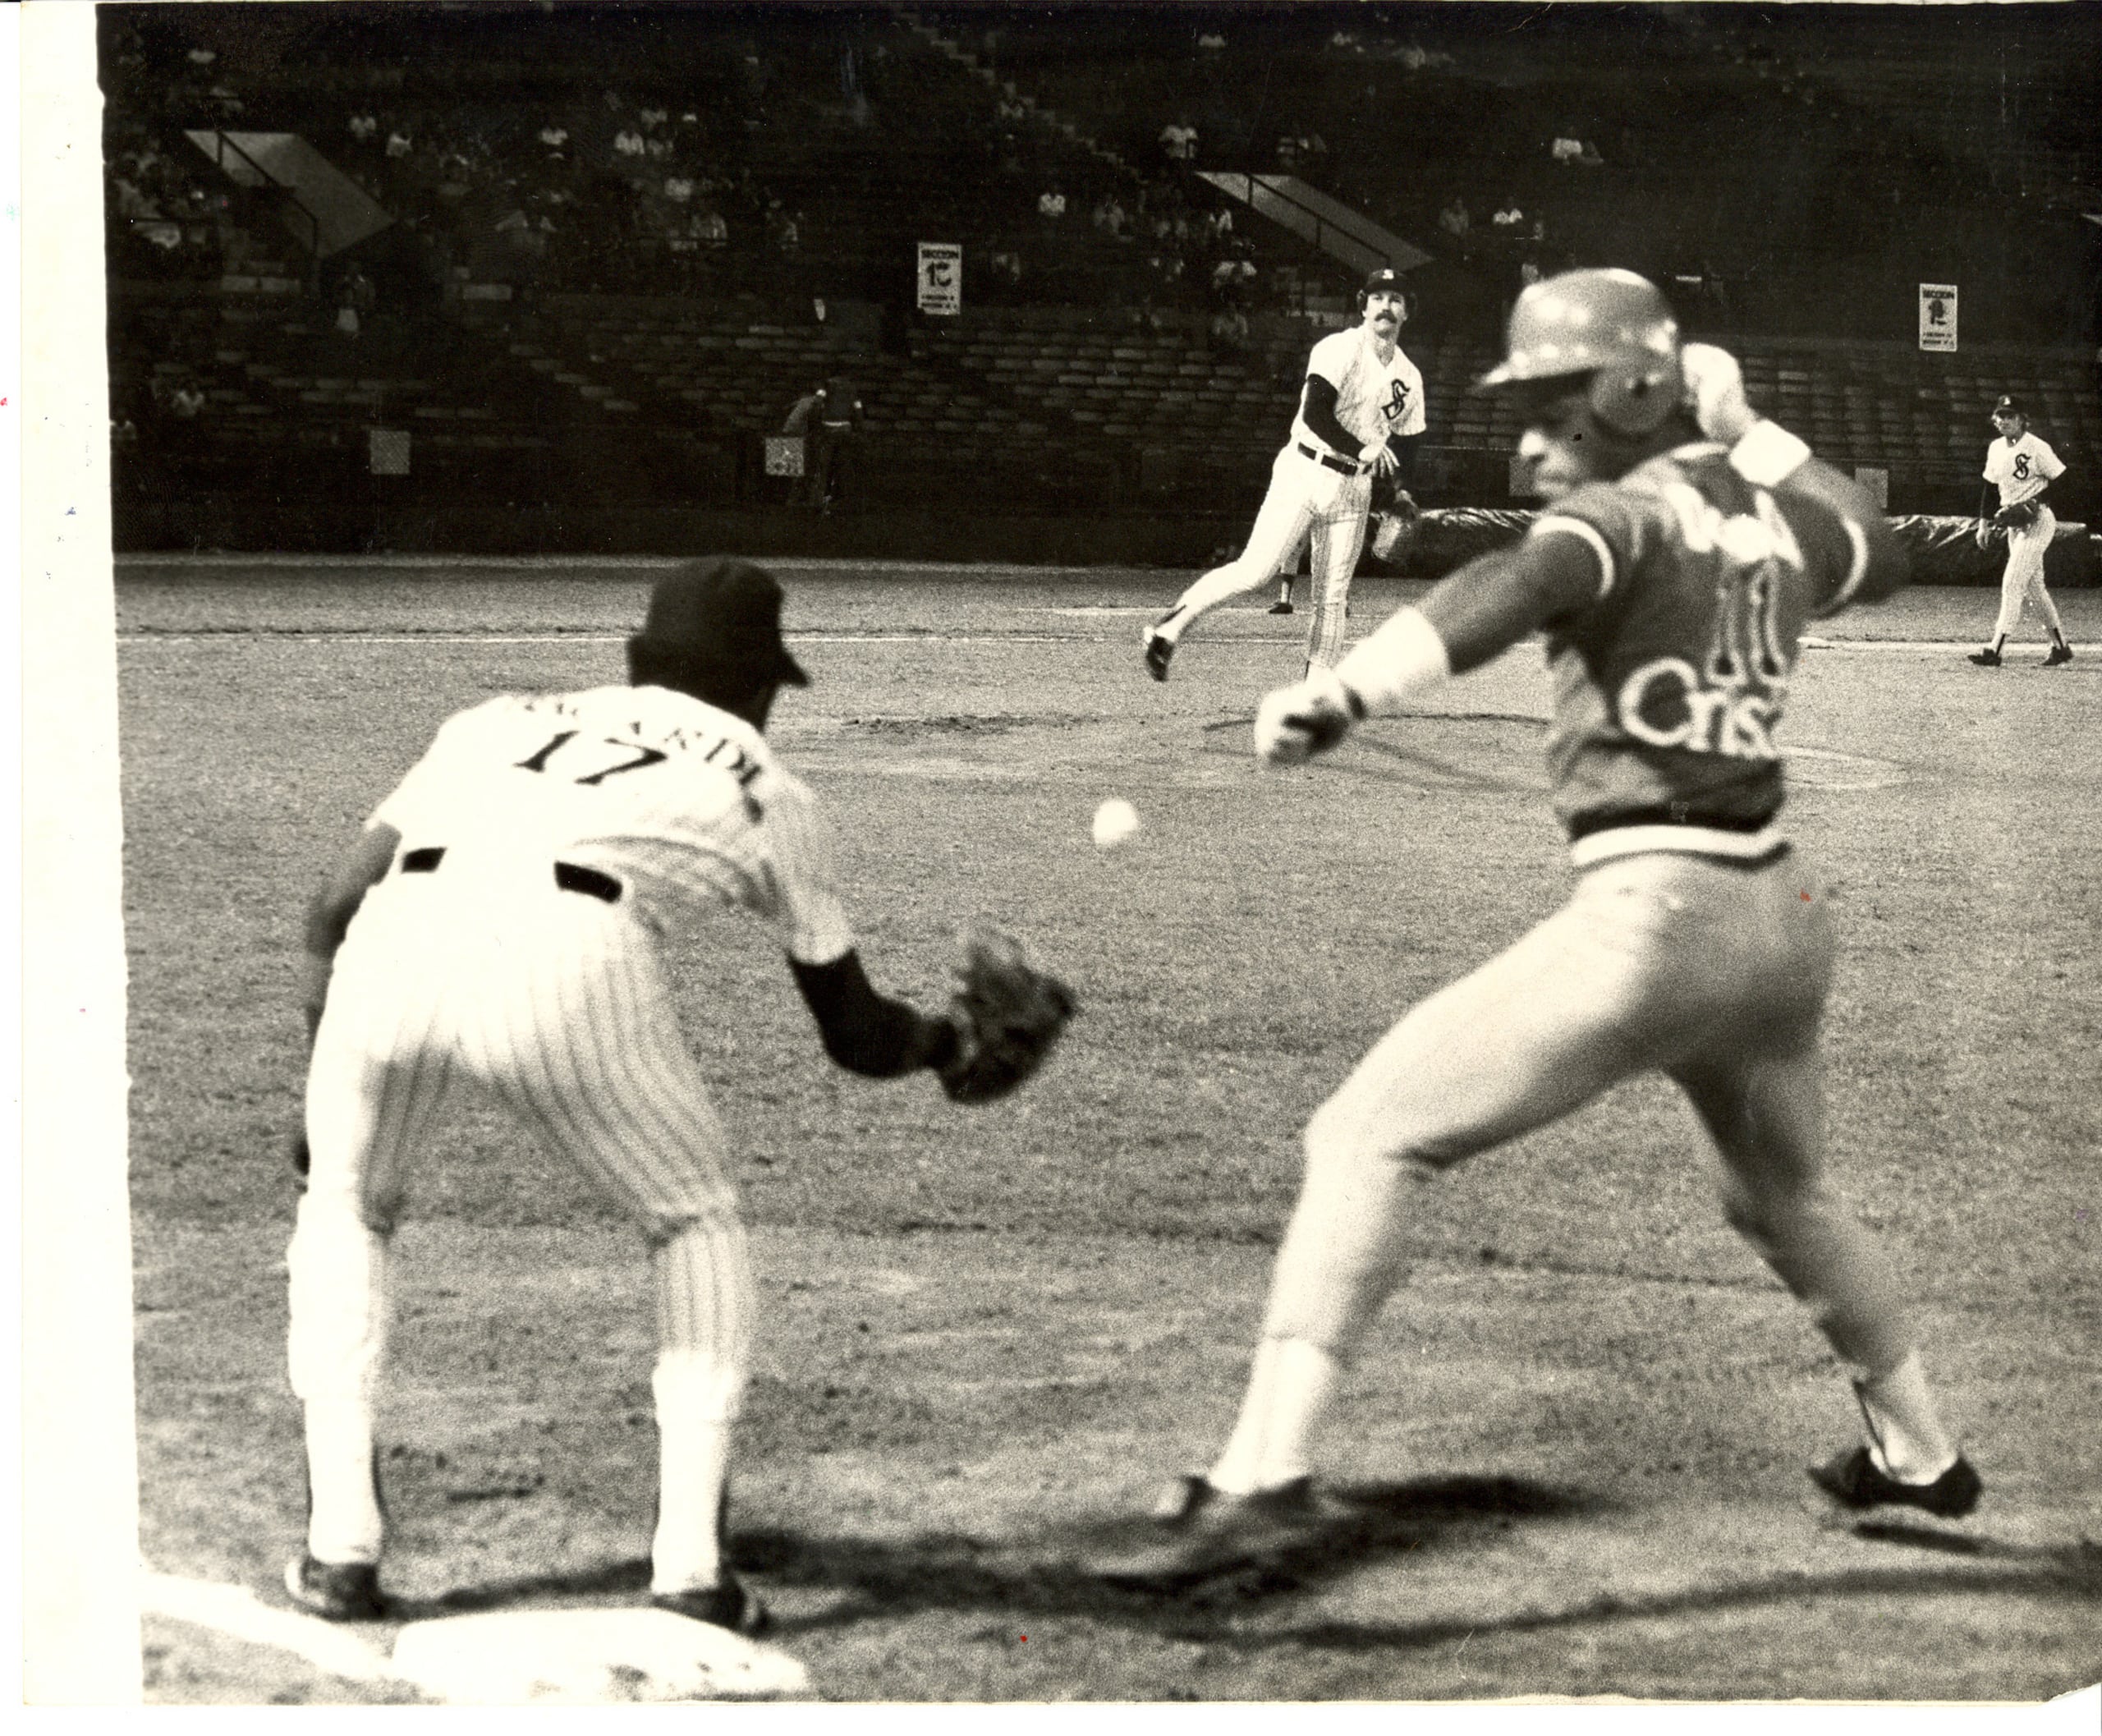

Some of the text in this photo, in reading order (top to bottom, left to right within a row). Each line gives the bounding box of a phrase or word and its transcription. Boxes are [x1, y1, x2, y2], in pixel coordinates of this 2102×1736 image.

[1381, 378, 1411, 420] S
[2013, 452, 2031, 480] S
[512, 729, 668, 786] 17
